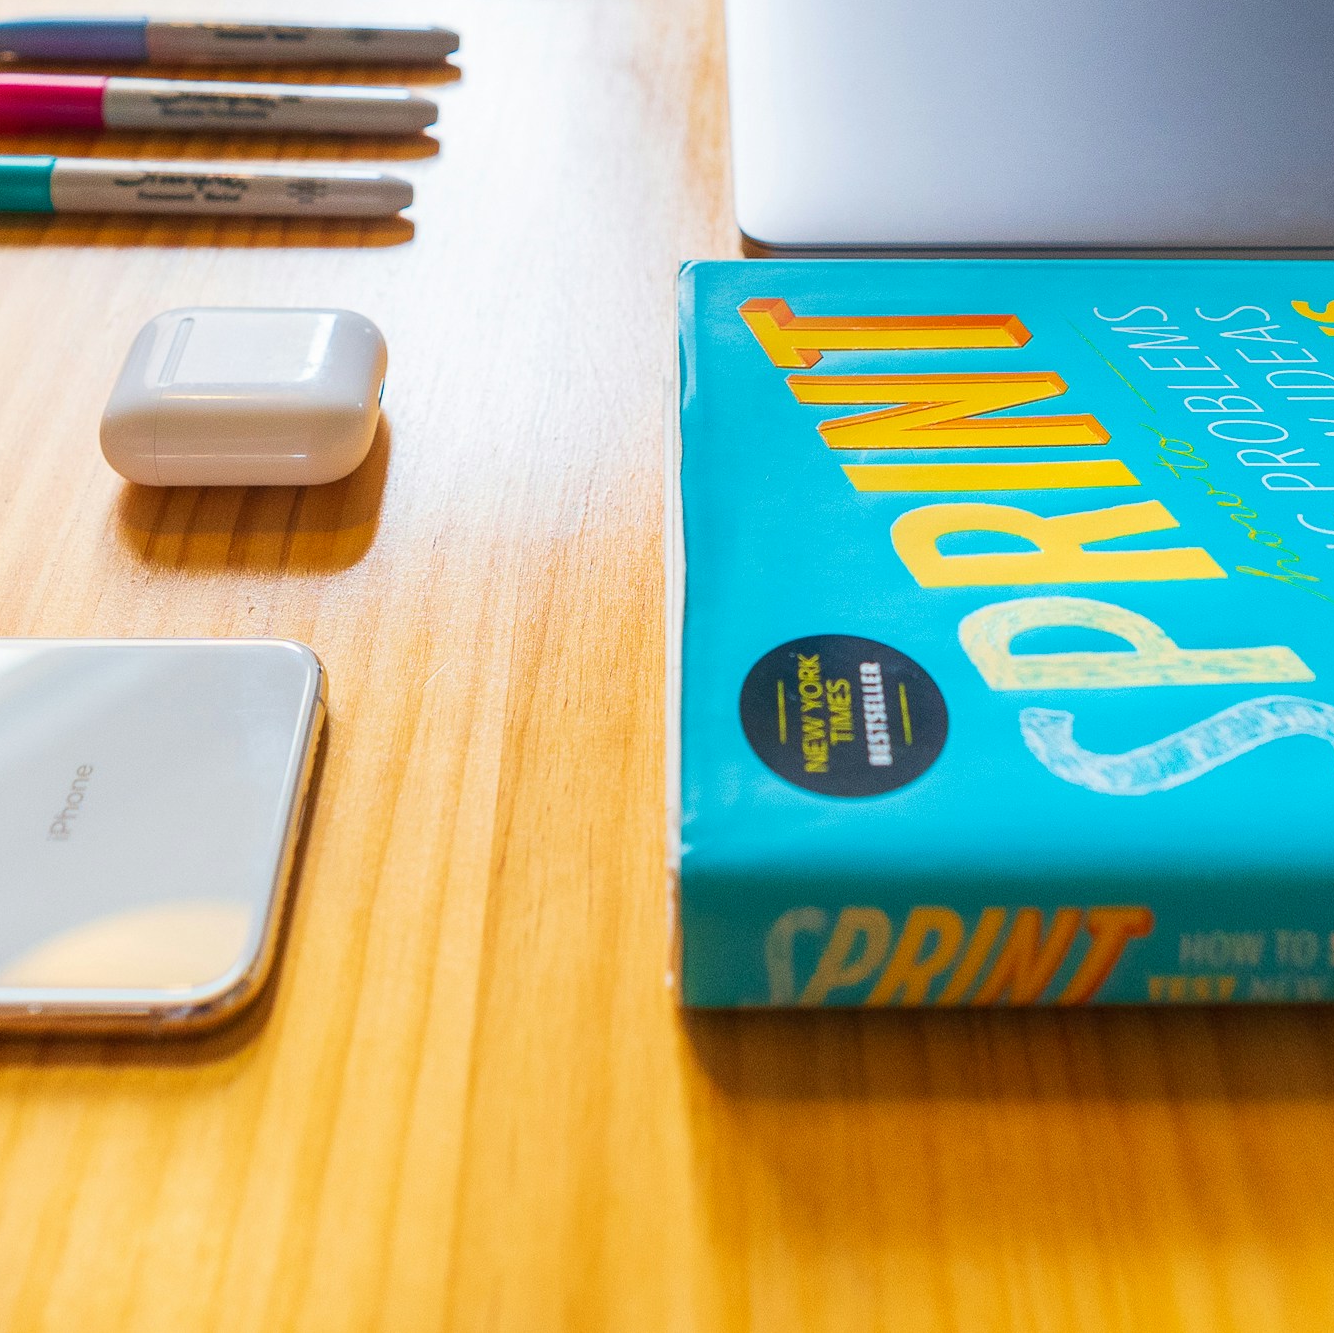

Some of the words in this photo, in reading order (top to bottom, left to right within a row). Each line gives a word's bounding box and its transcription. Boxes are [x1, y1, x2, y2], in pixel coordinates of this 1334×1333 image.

[1139, 422, 1210, 479] to
[1192, 477, 1323, 586] how
[797, 653, 824, 713] YORK
[825, 678, 855, 746] TIMES
[859, 662, 894, 766] BESTSELLER
[801, 715, 829, 773] NEW
[49, 764, 93, 841] iPhone
[762, 905, 1156, 1007] SPRINT
